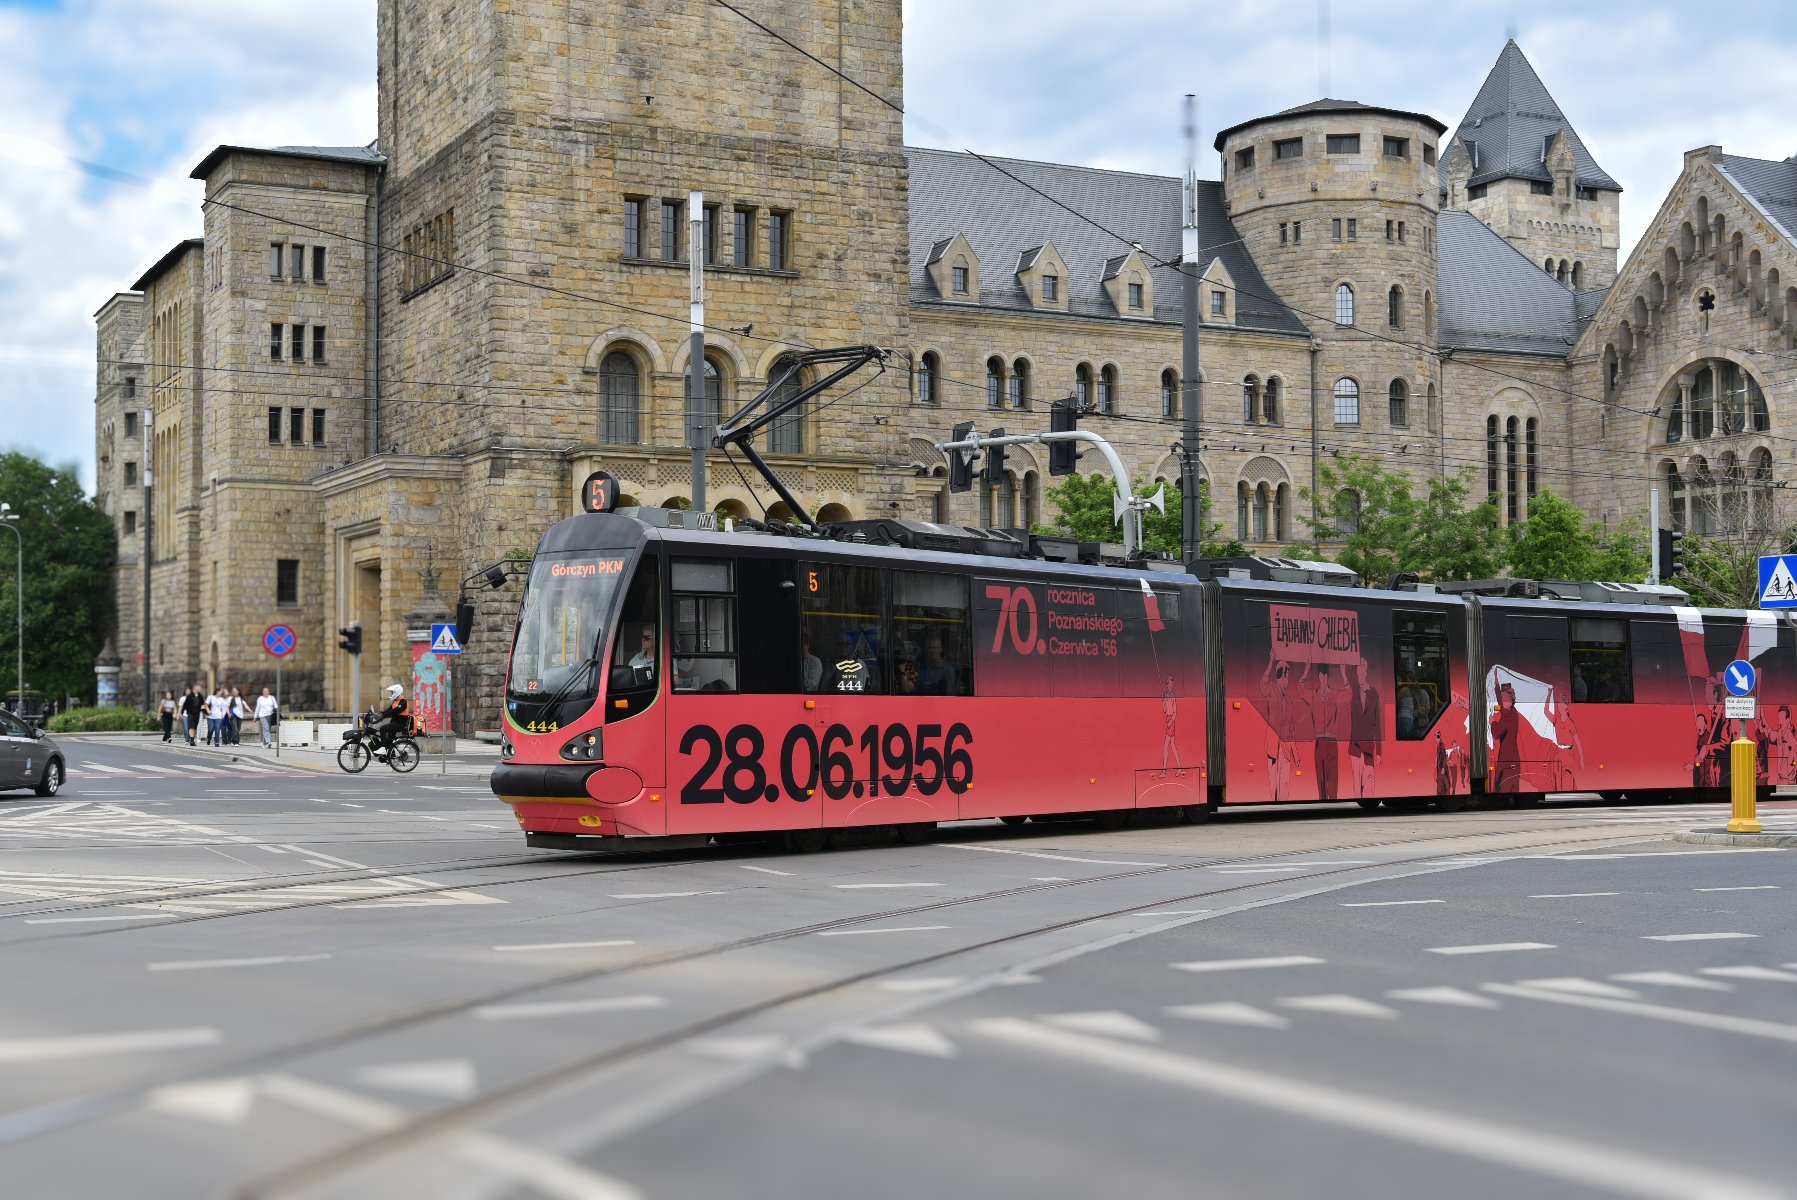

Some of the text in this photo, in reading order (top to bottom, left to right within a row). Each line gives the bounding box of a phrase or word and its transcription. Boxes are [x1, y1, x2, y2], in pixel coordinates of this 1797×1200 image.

[592, 479, 605, 510] 5
[551, 560, 624, 578] Górczyn PKM
[809, 571, 818, 592] 5
[1047, 588, 1095, 606] rocznica
[985, 585, 1046, 655] 70.
[1048, 610, 1124, 636] Poznańskiego
[1275, 611, 1358, 652] ŻĄDAMY CHLEBA
[1049, 636, 1099, 656] Czerwca
[528, 681, 538, 690] 22
[837, 680, 863, 691] 444
[526, 720, 559, 732] 444
[679, 722, 974, 804] 28.06.1956
